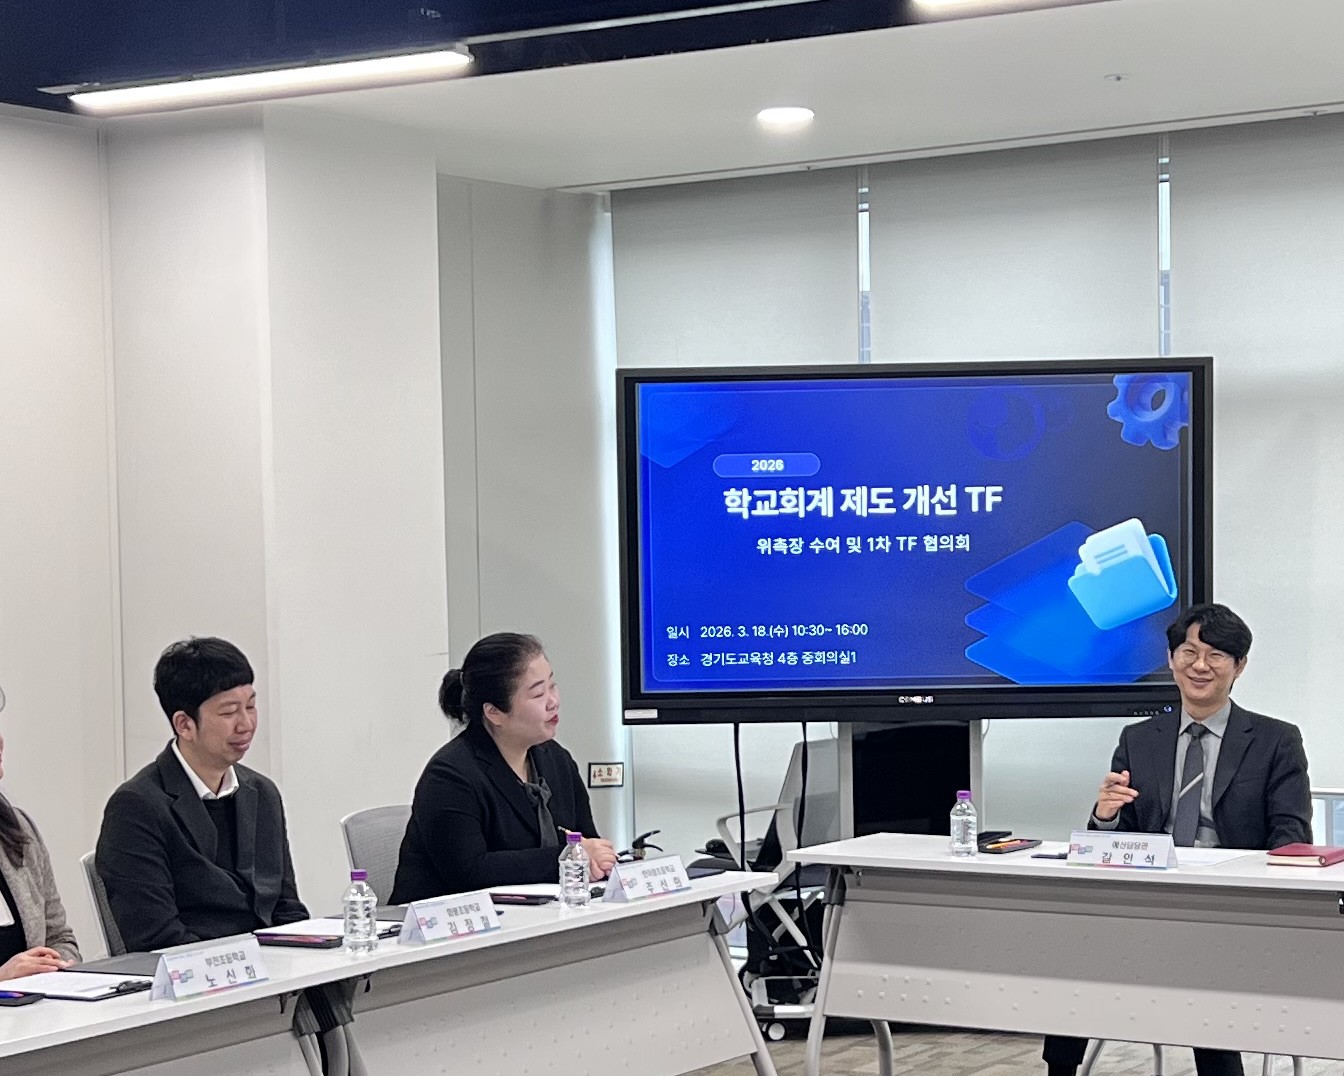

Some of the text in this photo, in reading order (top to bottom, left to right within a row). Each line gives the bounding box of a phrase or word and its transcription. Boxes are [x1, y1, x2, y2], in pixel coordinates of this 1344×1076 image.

[751, 459, 784, 472] 2026
[723, 484, 1003, 519] 학교회계 제도 개선 TF
[756, 534, 970, 555] 위촉장 수여 및 1차 TF 협의회
[667, 624, 868, 639] 일시 2026. 3. 18.(수) 10:30~ 16:00
[667, 651, 856, 666] 장소 경기도교육청 4층 중회의실1
